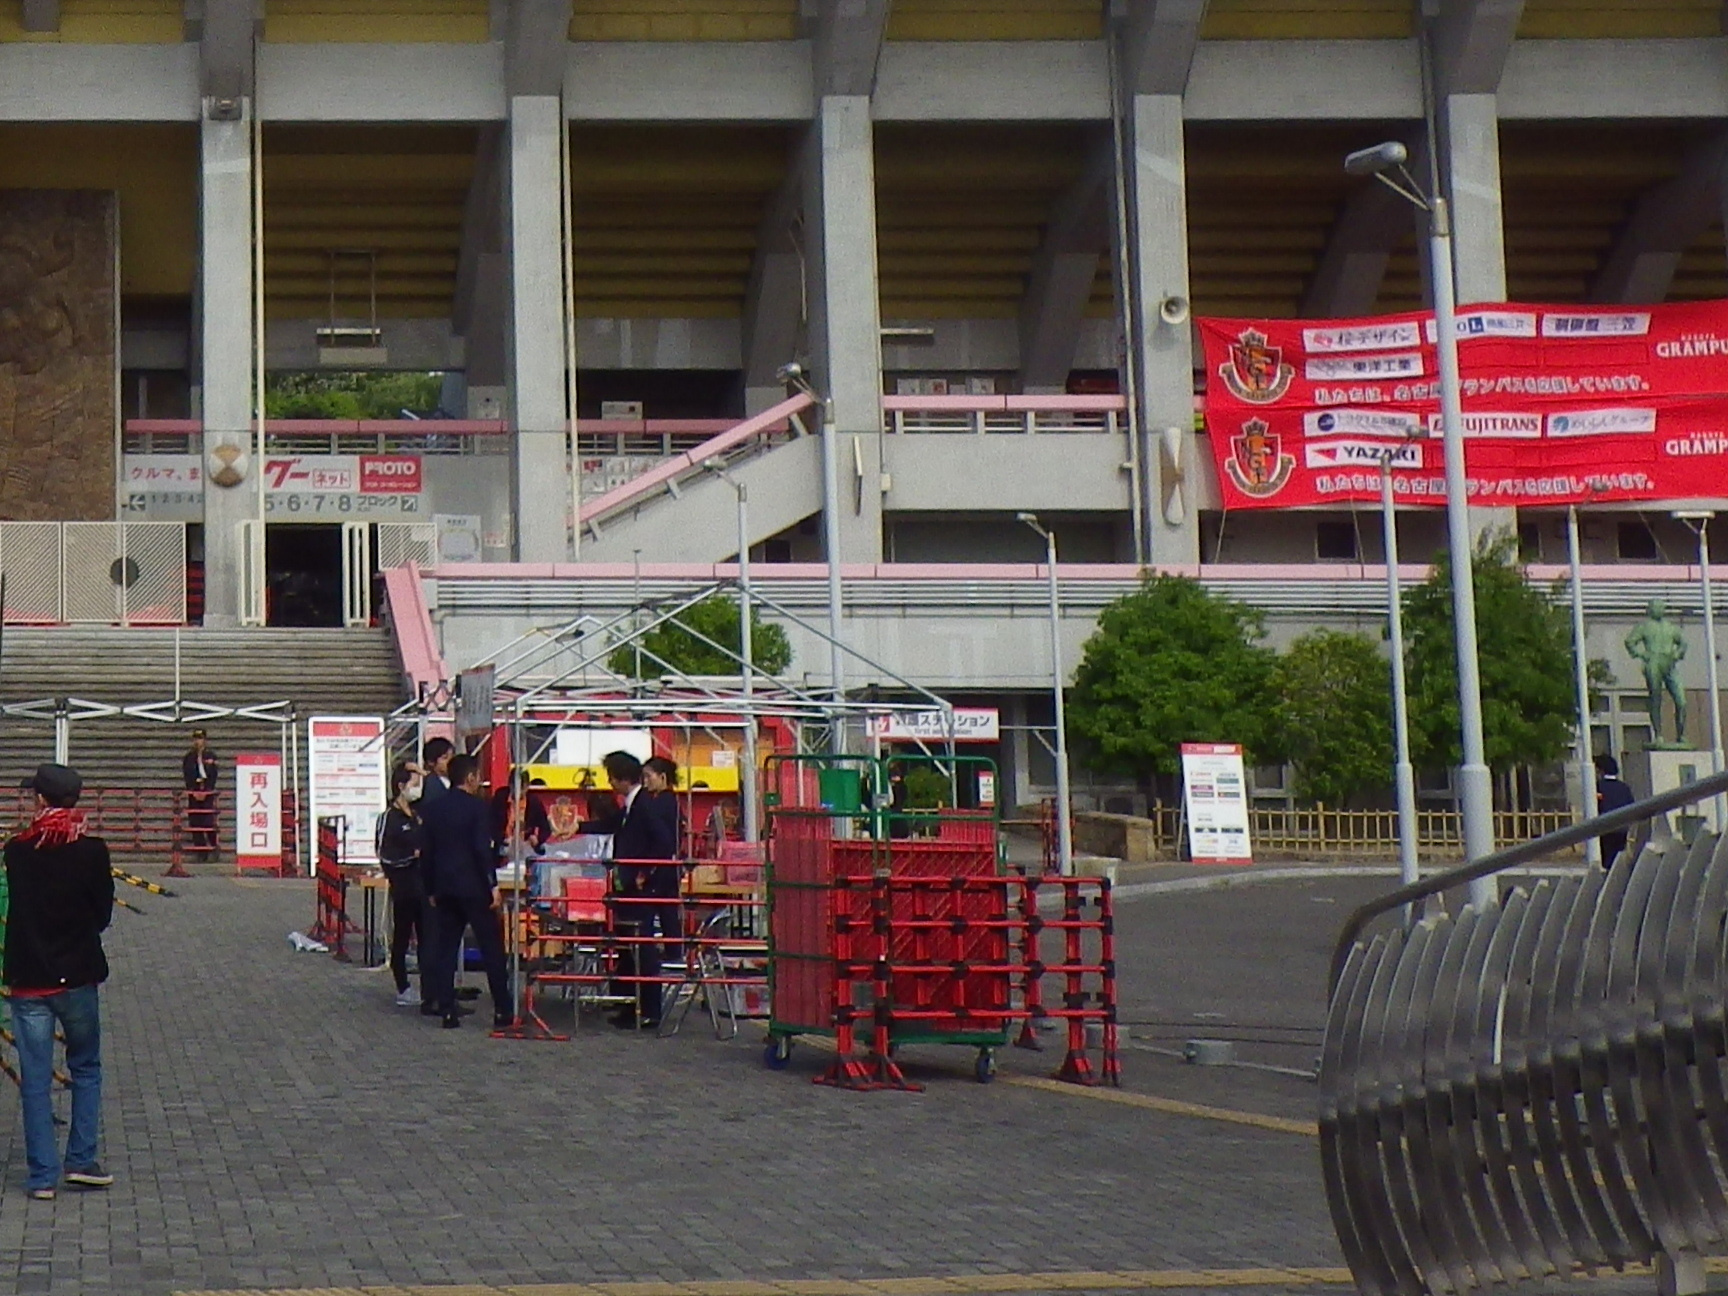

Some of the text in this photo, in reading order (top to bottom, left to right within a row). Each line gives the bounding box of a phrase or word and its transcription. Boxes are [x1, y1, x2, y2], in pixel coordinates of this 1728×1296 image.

[1462, 417, 1539, 434] UJITRANS
[364, 461, 416, 476] PROTO
[316, 472, 349, 486] ネット
[249, 771, 269, 848] 再入場口
